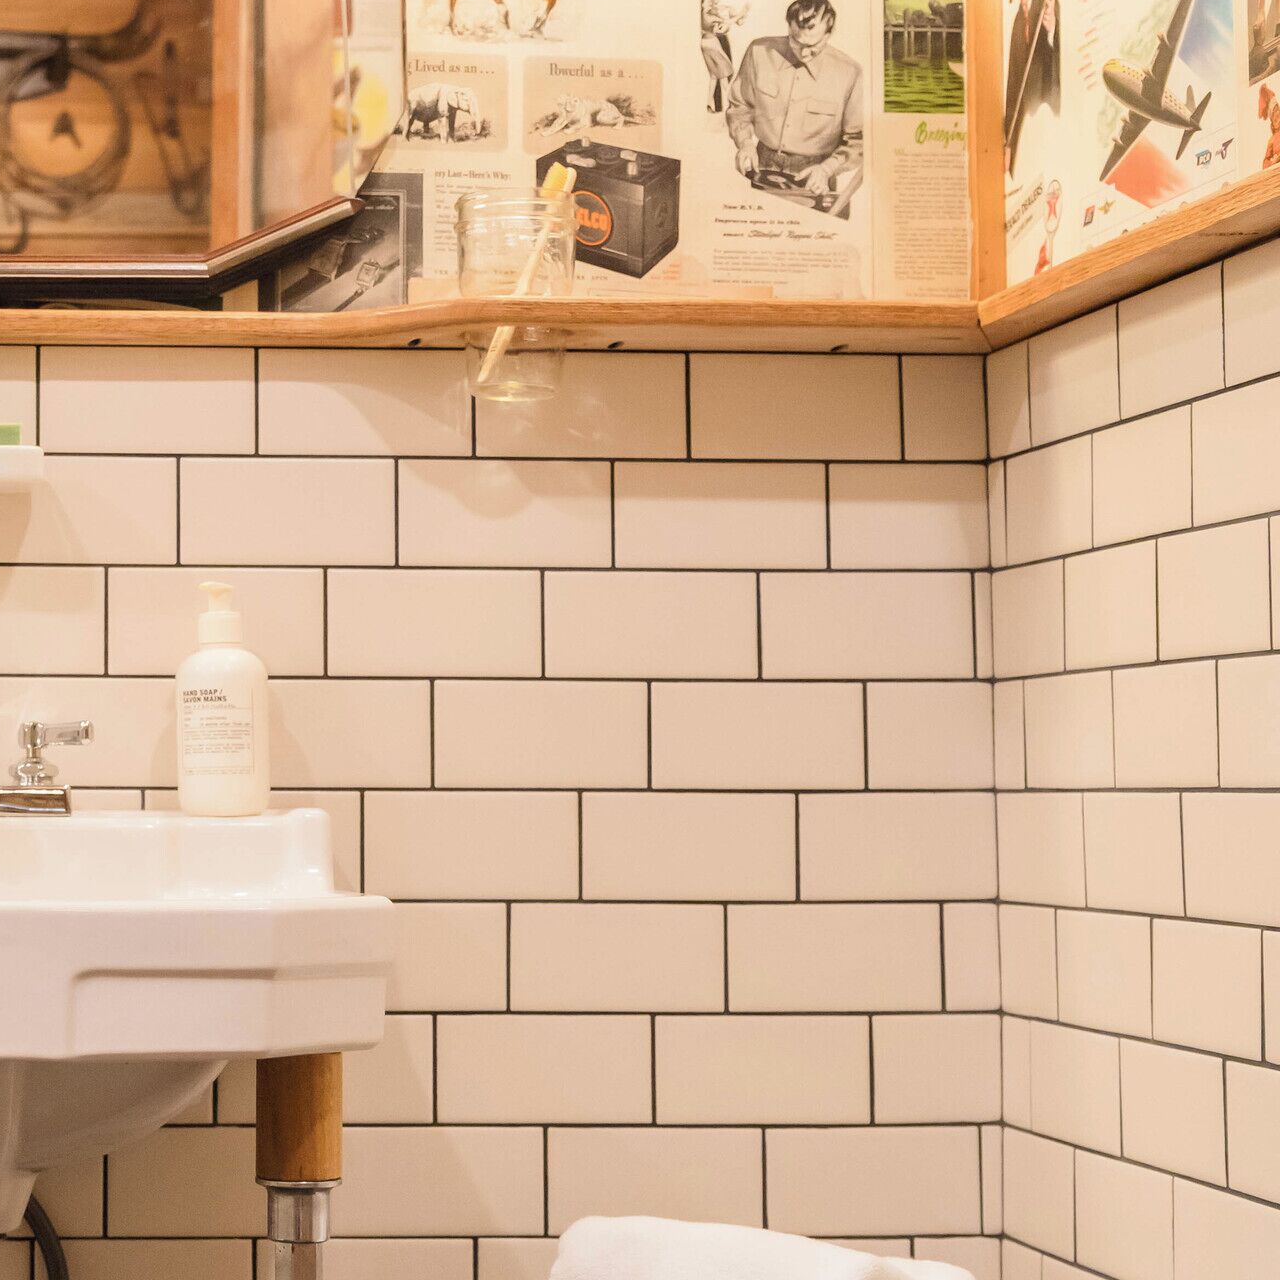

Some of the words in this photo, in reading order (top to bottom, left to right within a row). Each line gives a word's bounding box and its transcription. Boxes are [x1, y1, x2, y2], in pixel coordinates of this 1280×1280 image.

[415, 60, 447, 74] Lived
[448, 62, 462, 74] as
[549, 62, 594, 78] Powerful
[600, 67, 613, 78] as
[183, 689, 198, 697] HAND
